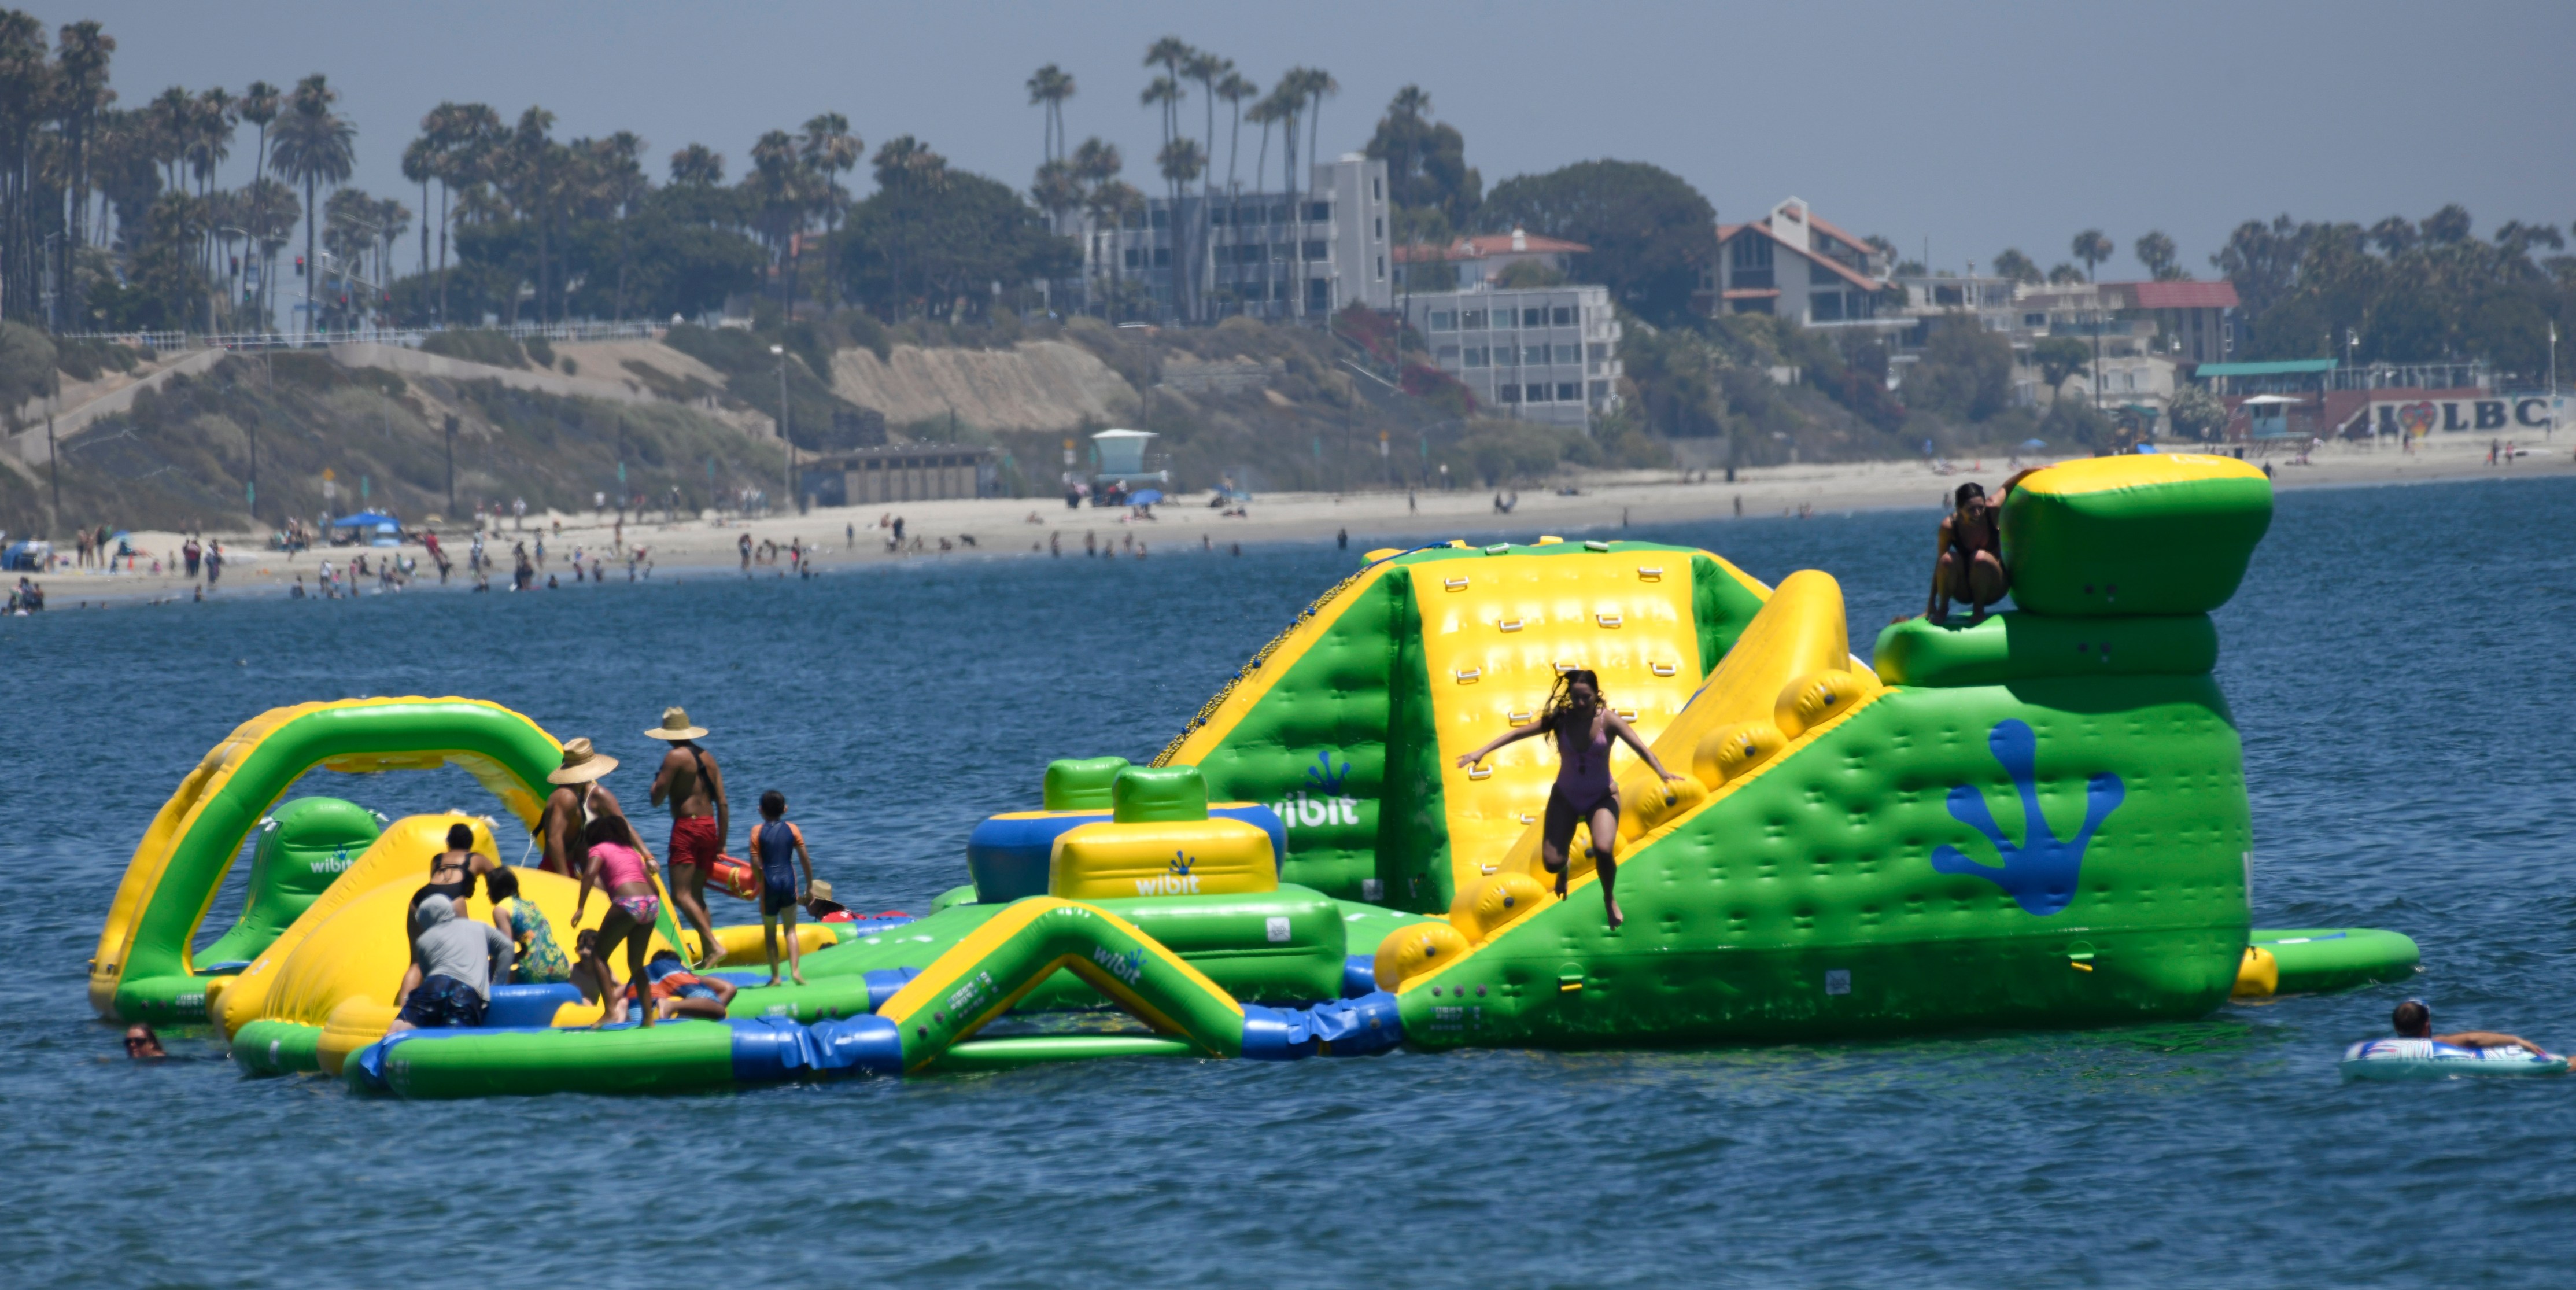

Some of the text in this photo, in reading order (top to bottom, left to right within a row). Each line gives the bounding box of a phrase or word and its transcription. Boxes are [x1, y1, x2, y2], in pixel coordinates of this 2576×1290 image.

[2442, 399, 2548, 431] LBC
[1135, 873, 1200, 895] wibit
[1093, 945, 1141, 986] wibit
